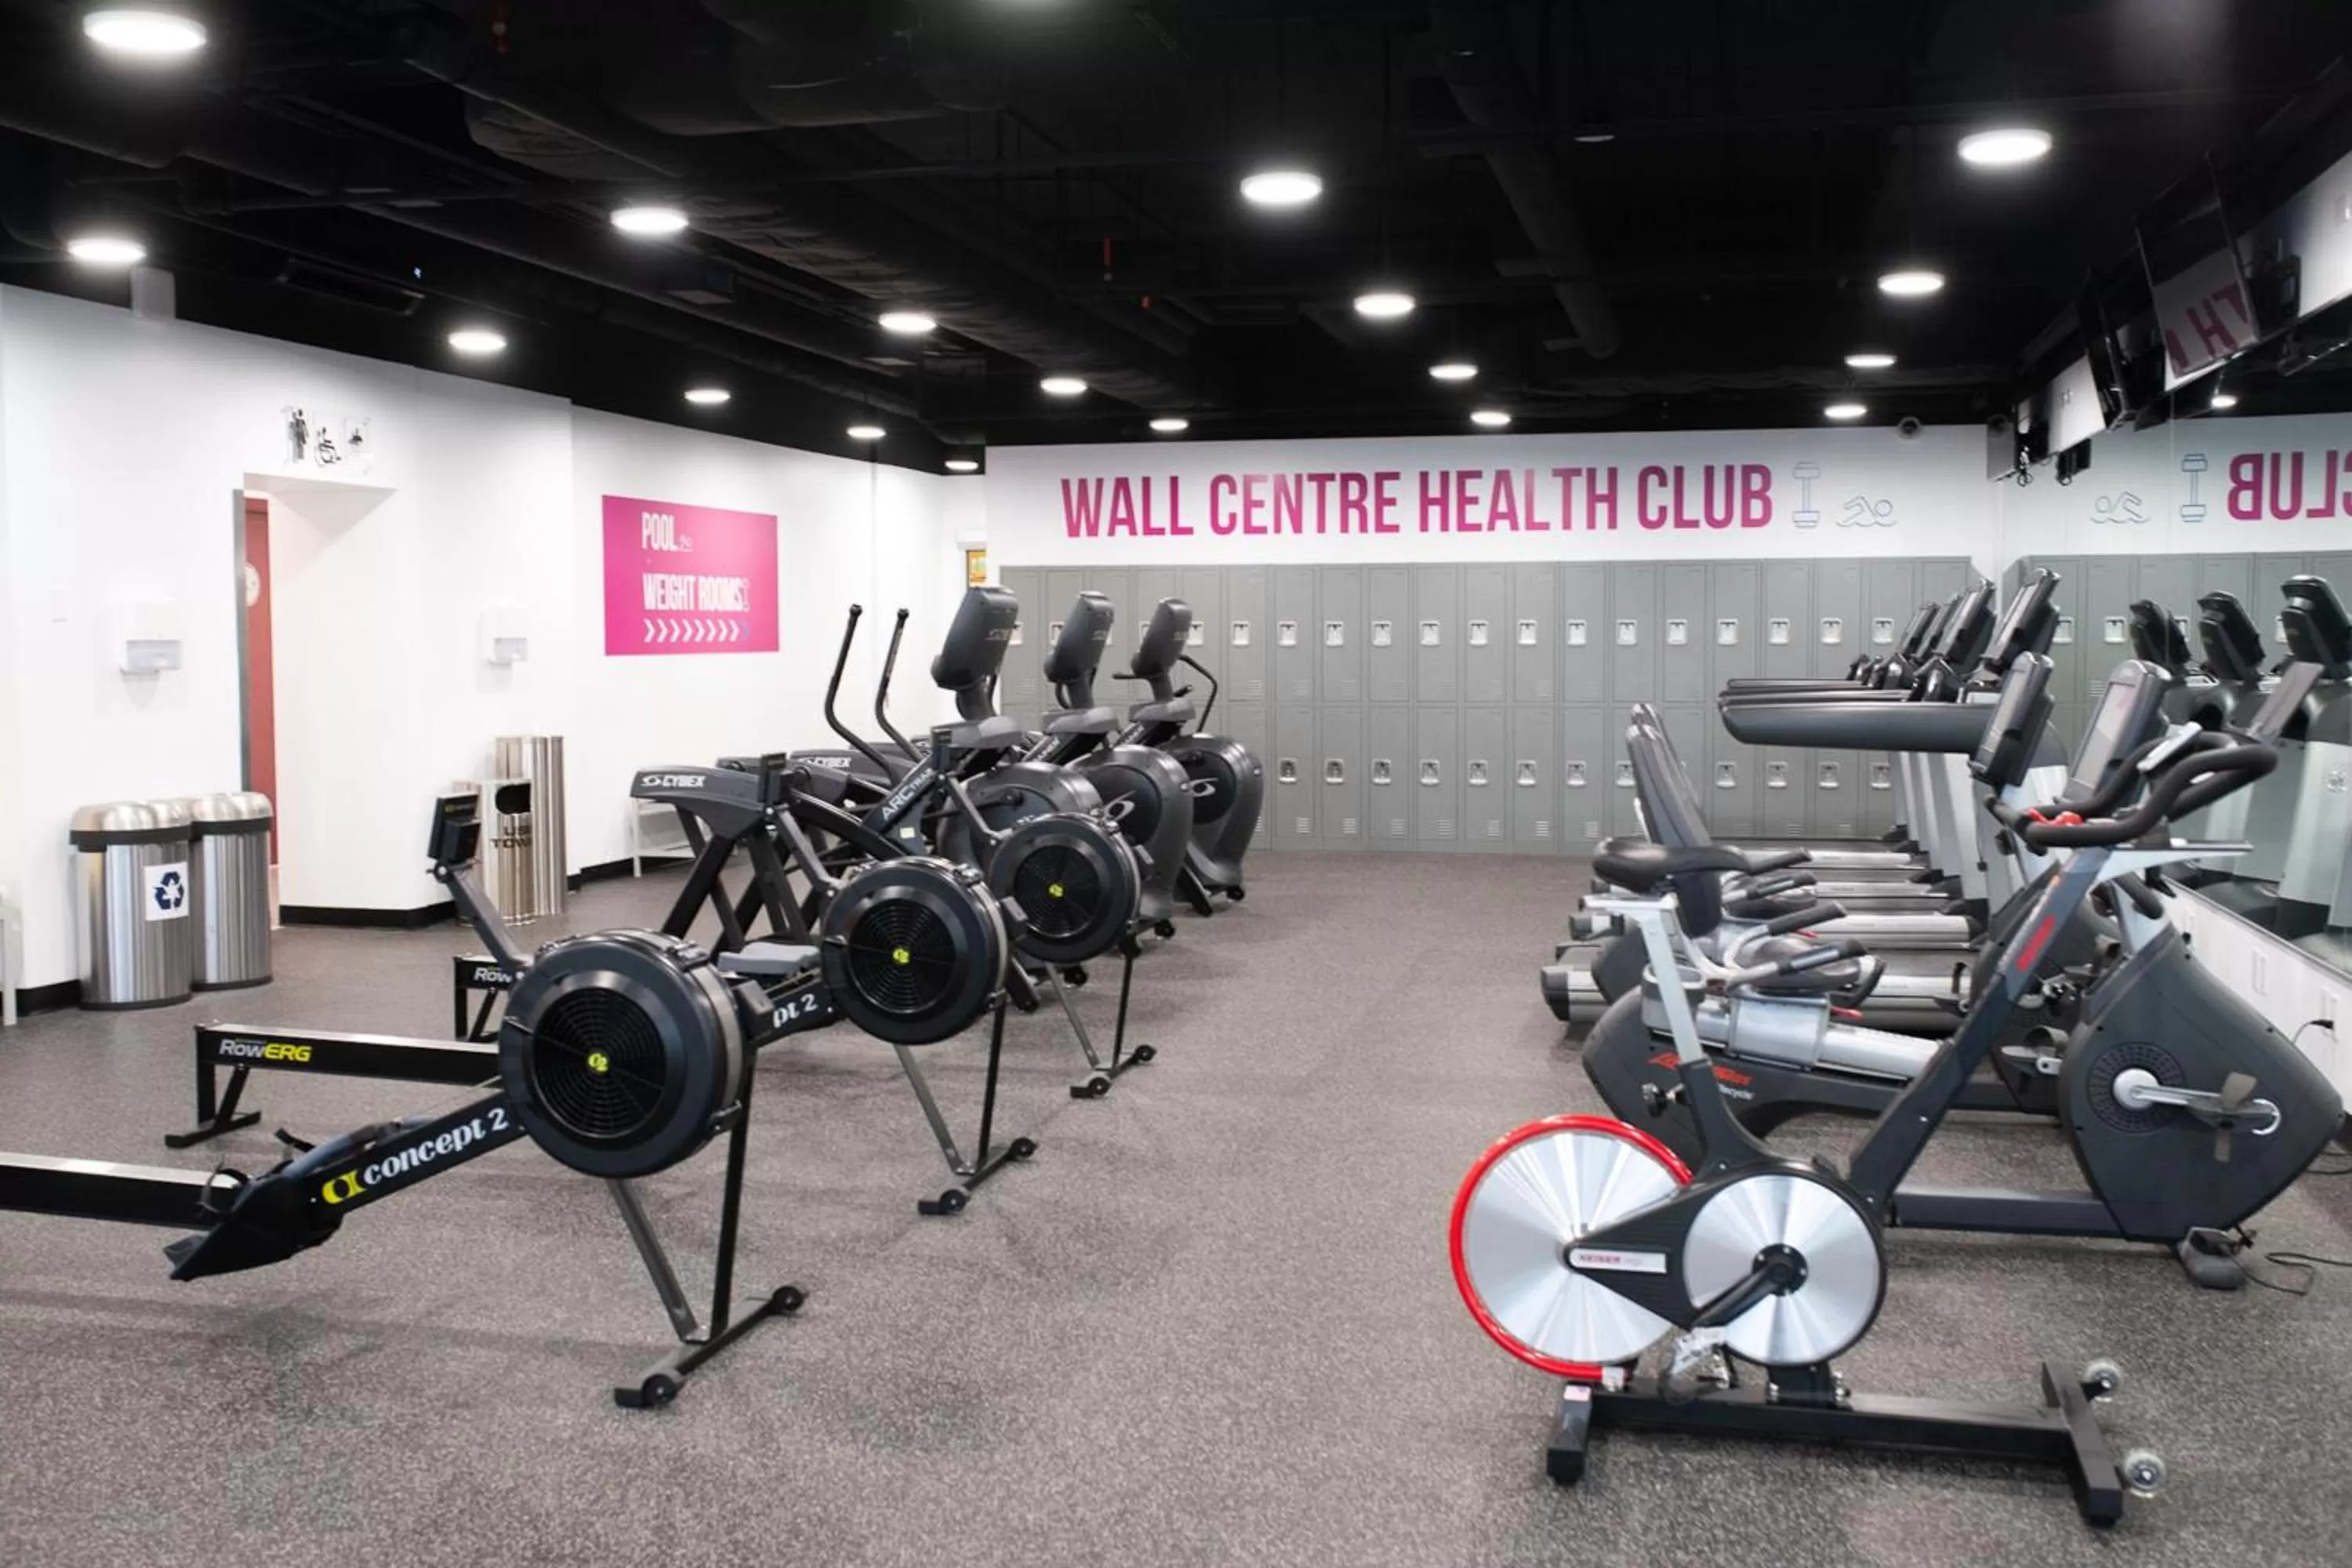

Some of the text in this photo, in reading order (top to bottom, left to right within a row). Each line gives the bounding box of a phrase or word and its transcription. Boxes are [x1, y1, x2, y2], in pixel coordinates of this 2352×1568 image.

[1061, 463, 1774, 539] WALL CENTRE HEALTH CLUB
[642, 512, 679, 552] POOL
[642, 572, 744, 612] WEIGHT ROOMS
[800, 993, 818, 1012] 2
[219, 1038, 312, 1062] RowERG
[363, 1107, 509, 1185] concept 2
